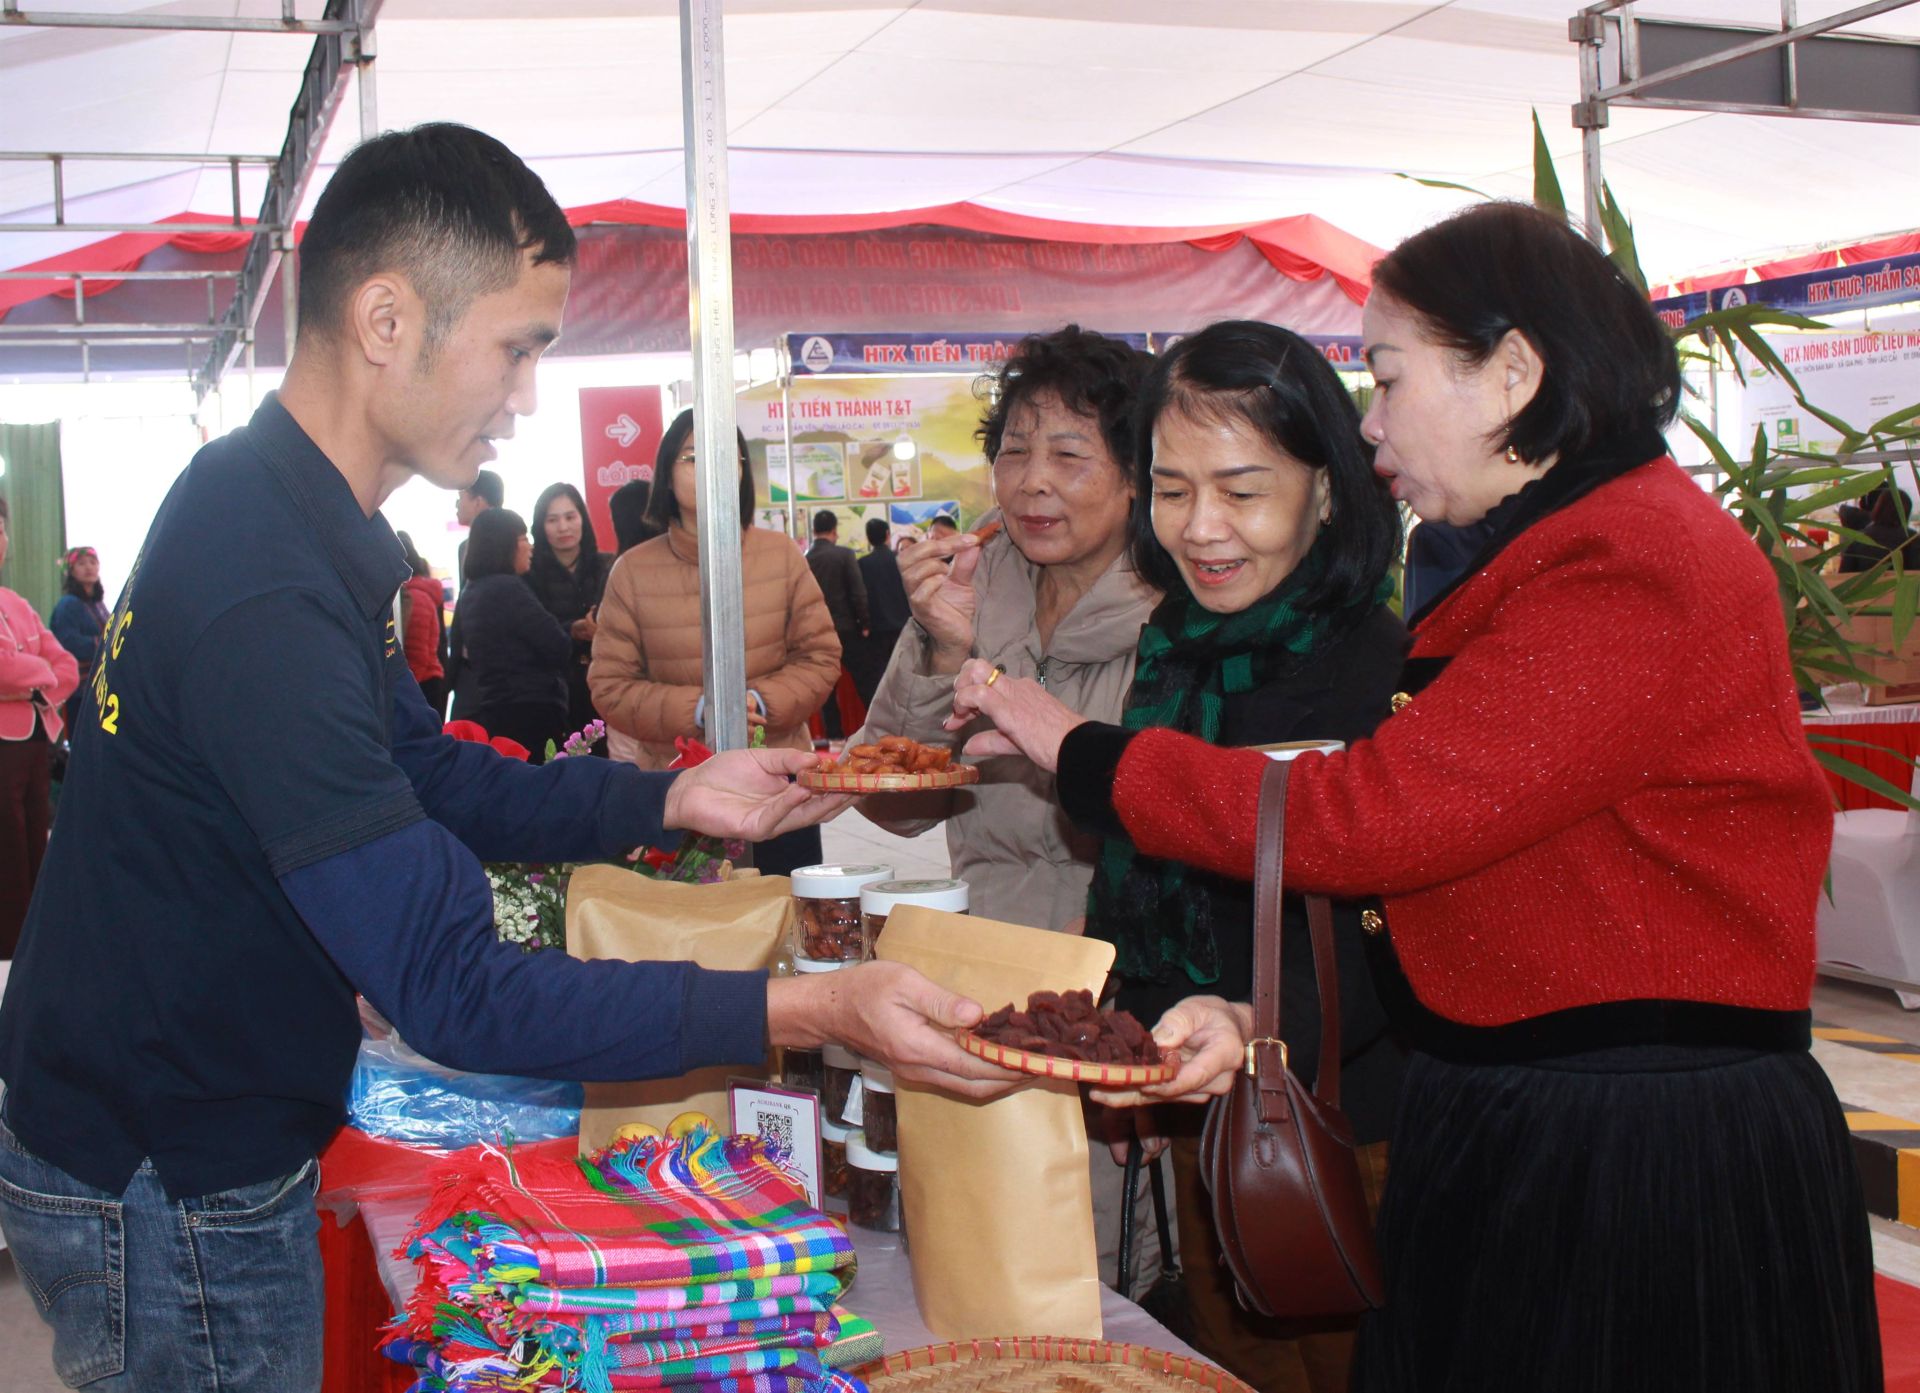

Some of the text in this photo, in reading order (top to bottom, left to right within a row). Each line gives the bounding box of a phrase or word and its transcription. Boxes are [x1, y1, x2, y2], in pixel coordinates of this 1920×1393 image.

[706, 128, 713, 147] 40
[707, 172, 715, 190] 40
[709, 198, 718, 234] LONG
[1808, 281, 1830, 305] HTX
[1832, 275, 1862, 302] THỰC
[1864, 263, 1901, 294] PHẨM
[863, 344, 907, 364] HTX
[912, 339, 961, 364] TIẾN
[1784, 346, 1800, 364] HTX
[1803, 340, 1829, 361] NÔNG
[799, 396, 832, 418] TIẾN
[836, 398, 882, 417] THÀNH
[886, 399, 912, 416] T&T
[598, 461, 627, 486] LỐI
